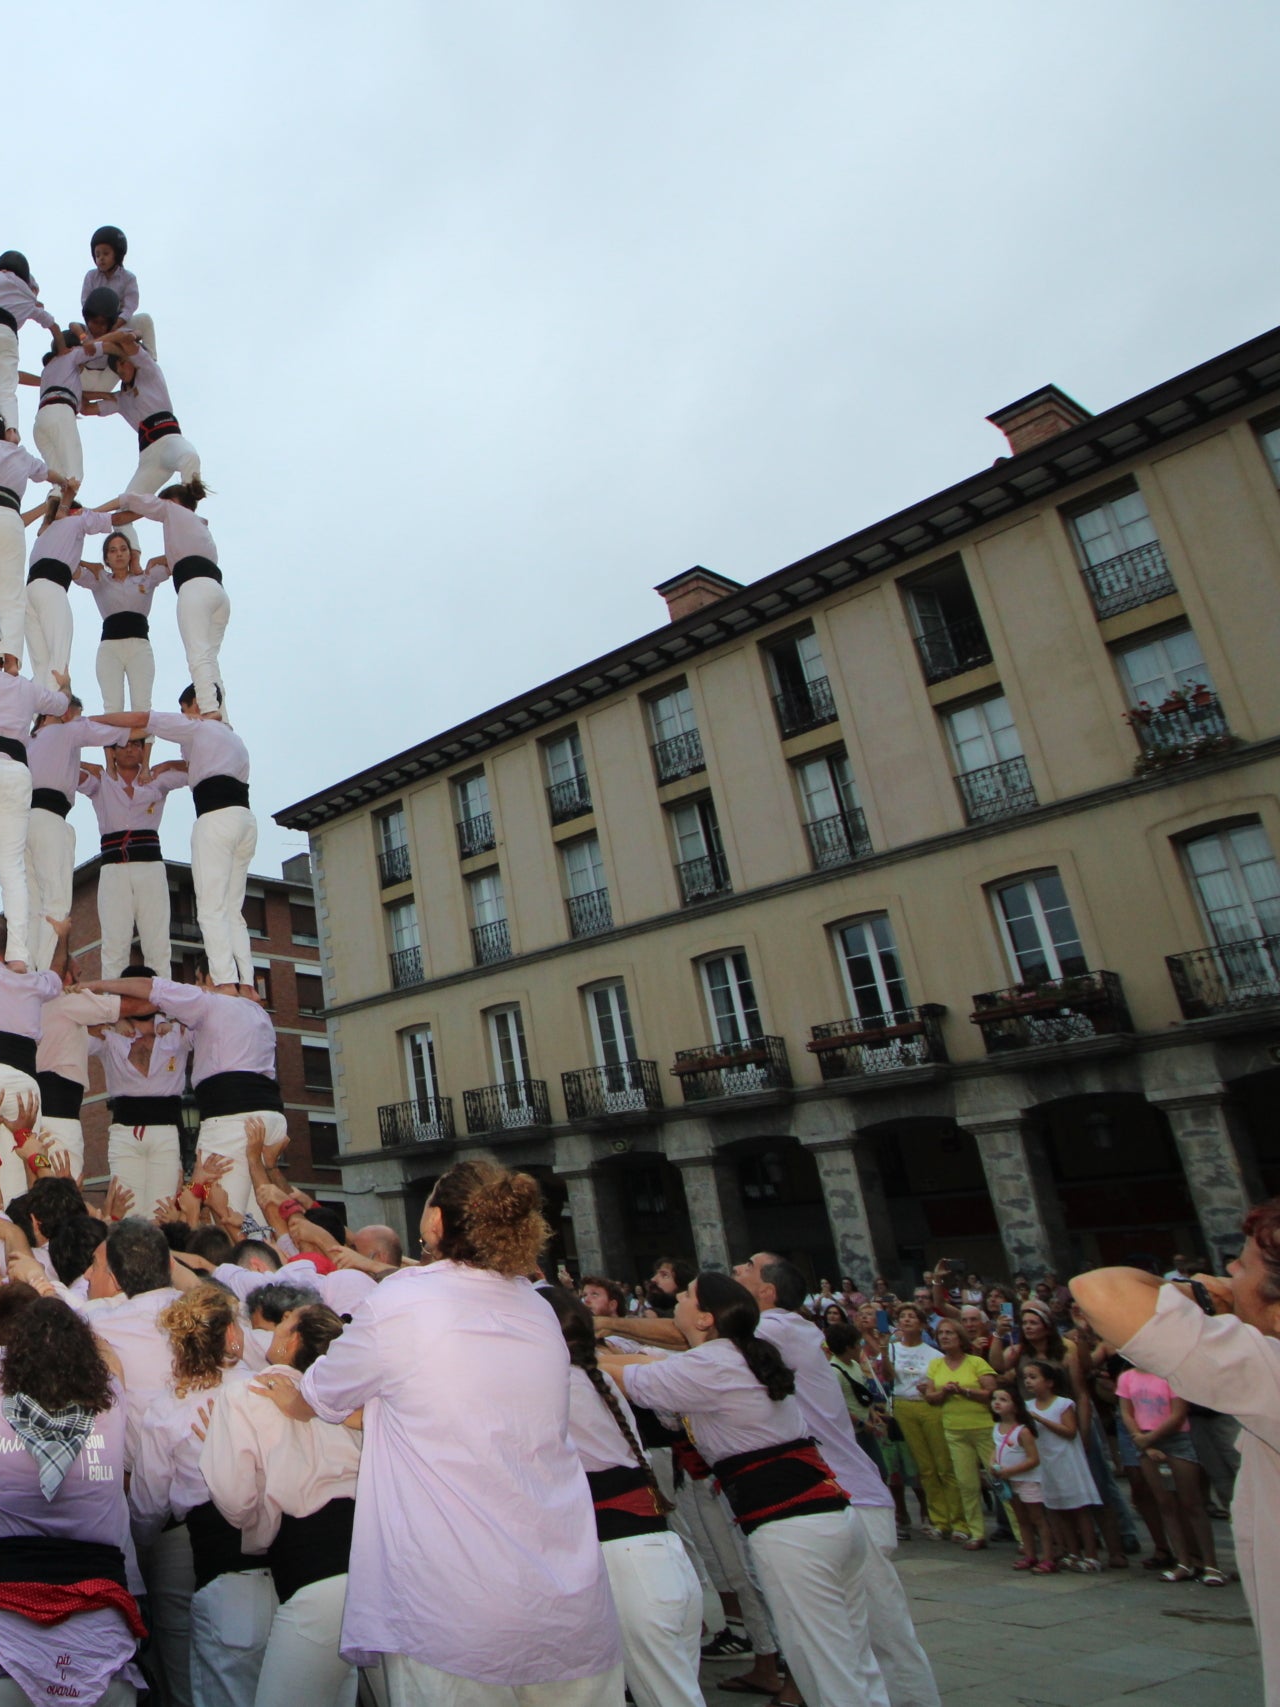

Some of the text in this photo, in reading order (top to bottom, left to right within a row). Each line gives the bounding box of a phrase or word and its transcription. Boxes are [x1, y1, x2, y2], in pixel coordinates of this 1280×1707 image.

[85, 1434, 105, 1449] SOM
[86, 1450, 100, 1464] LA
[88, 1465, 114, 1480] COLLA
[55, 1653, 72, 1669] pit
[47, 1684, 80, 1697] ovaris
